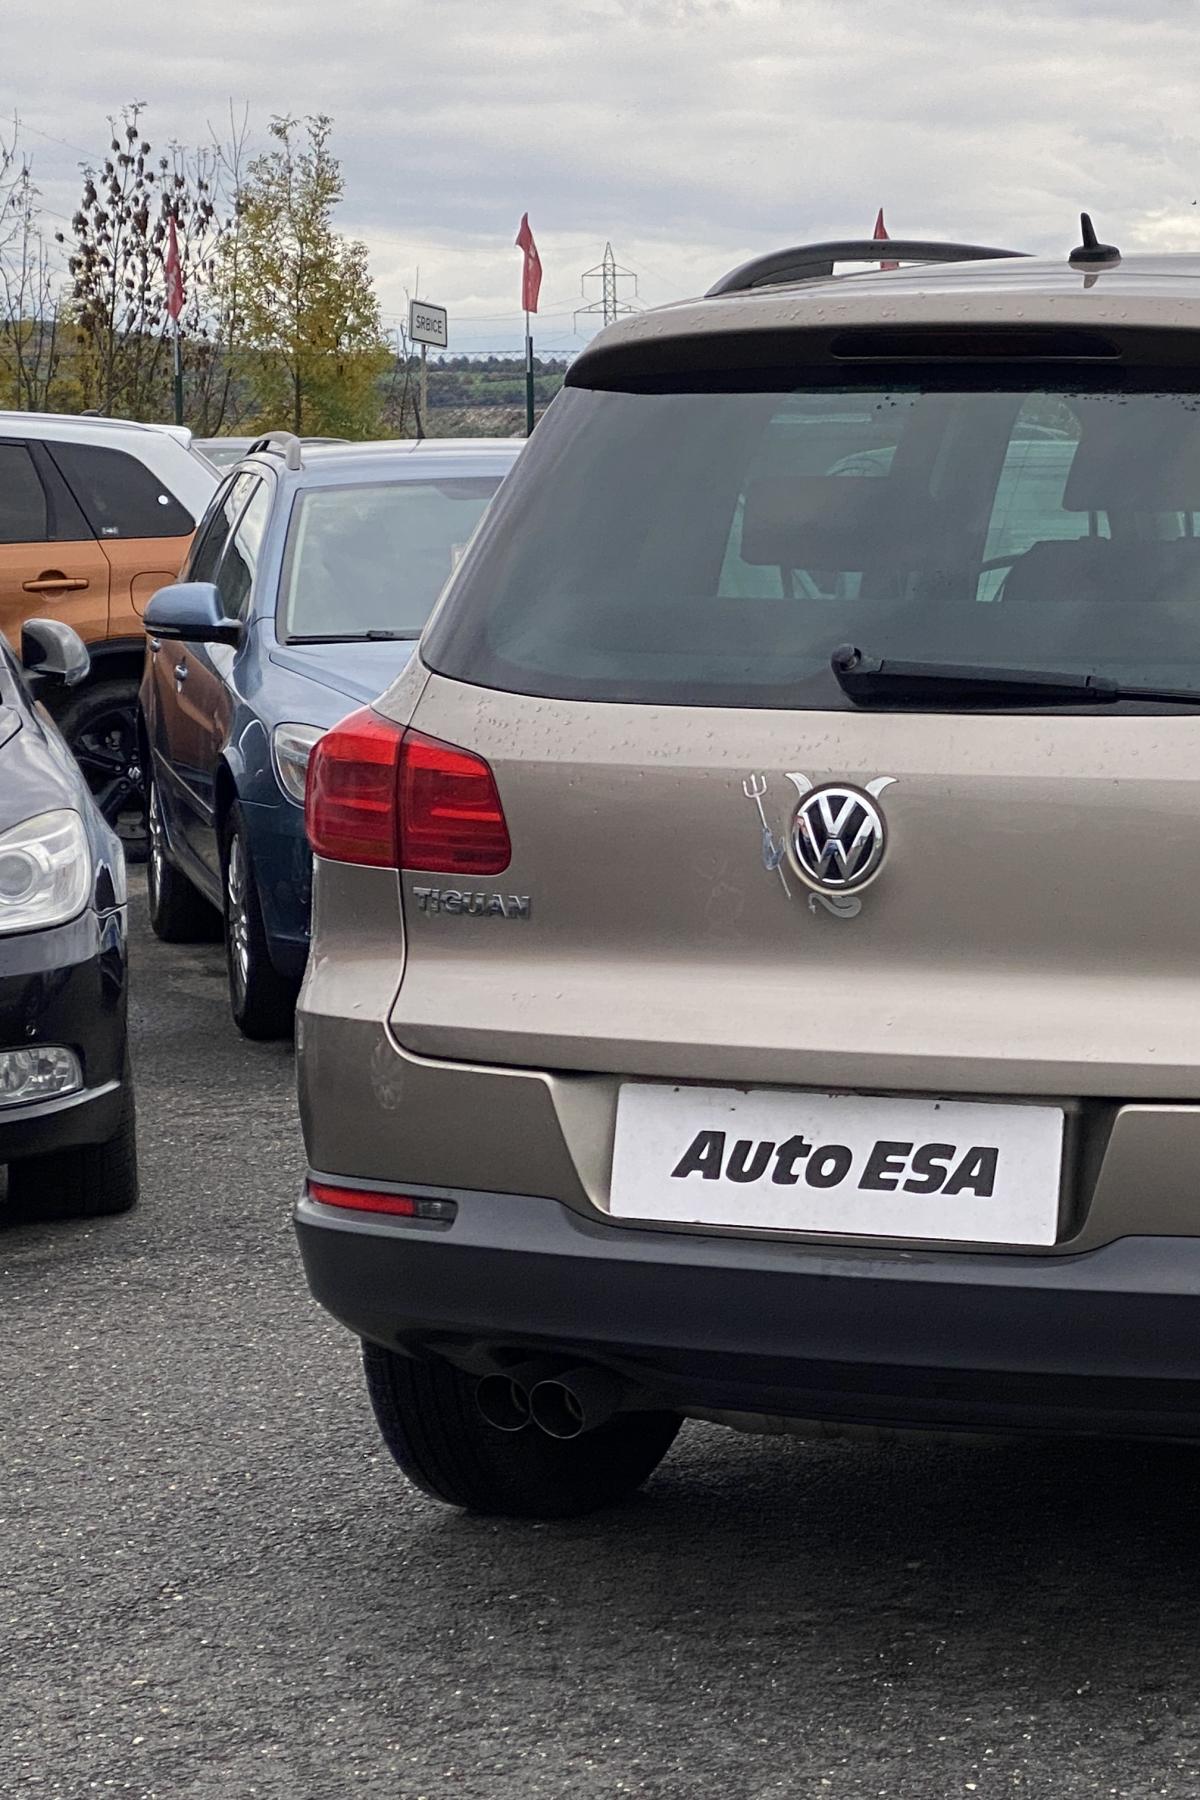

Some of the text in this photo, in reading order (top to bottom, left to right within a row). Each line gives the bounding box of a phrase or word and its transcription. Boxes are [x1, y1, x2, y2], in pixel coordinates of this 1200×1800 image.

[796, 788, 882, 884] VW
[412, 886, 530, 919] TIGUAN
[670, 1130, 1000, 1198] Auto ESA
